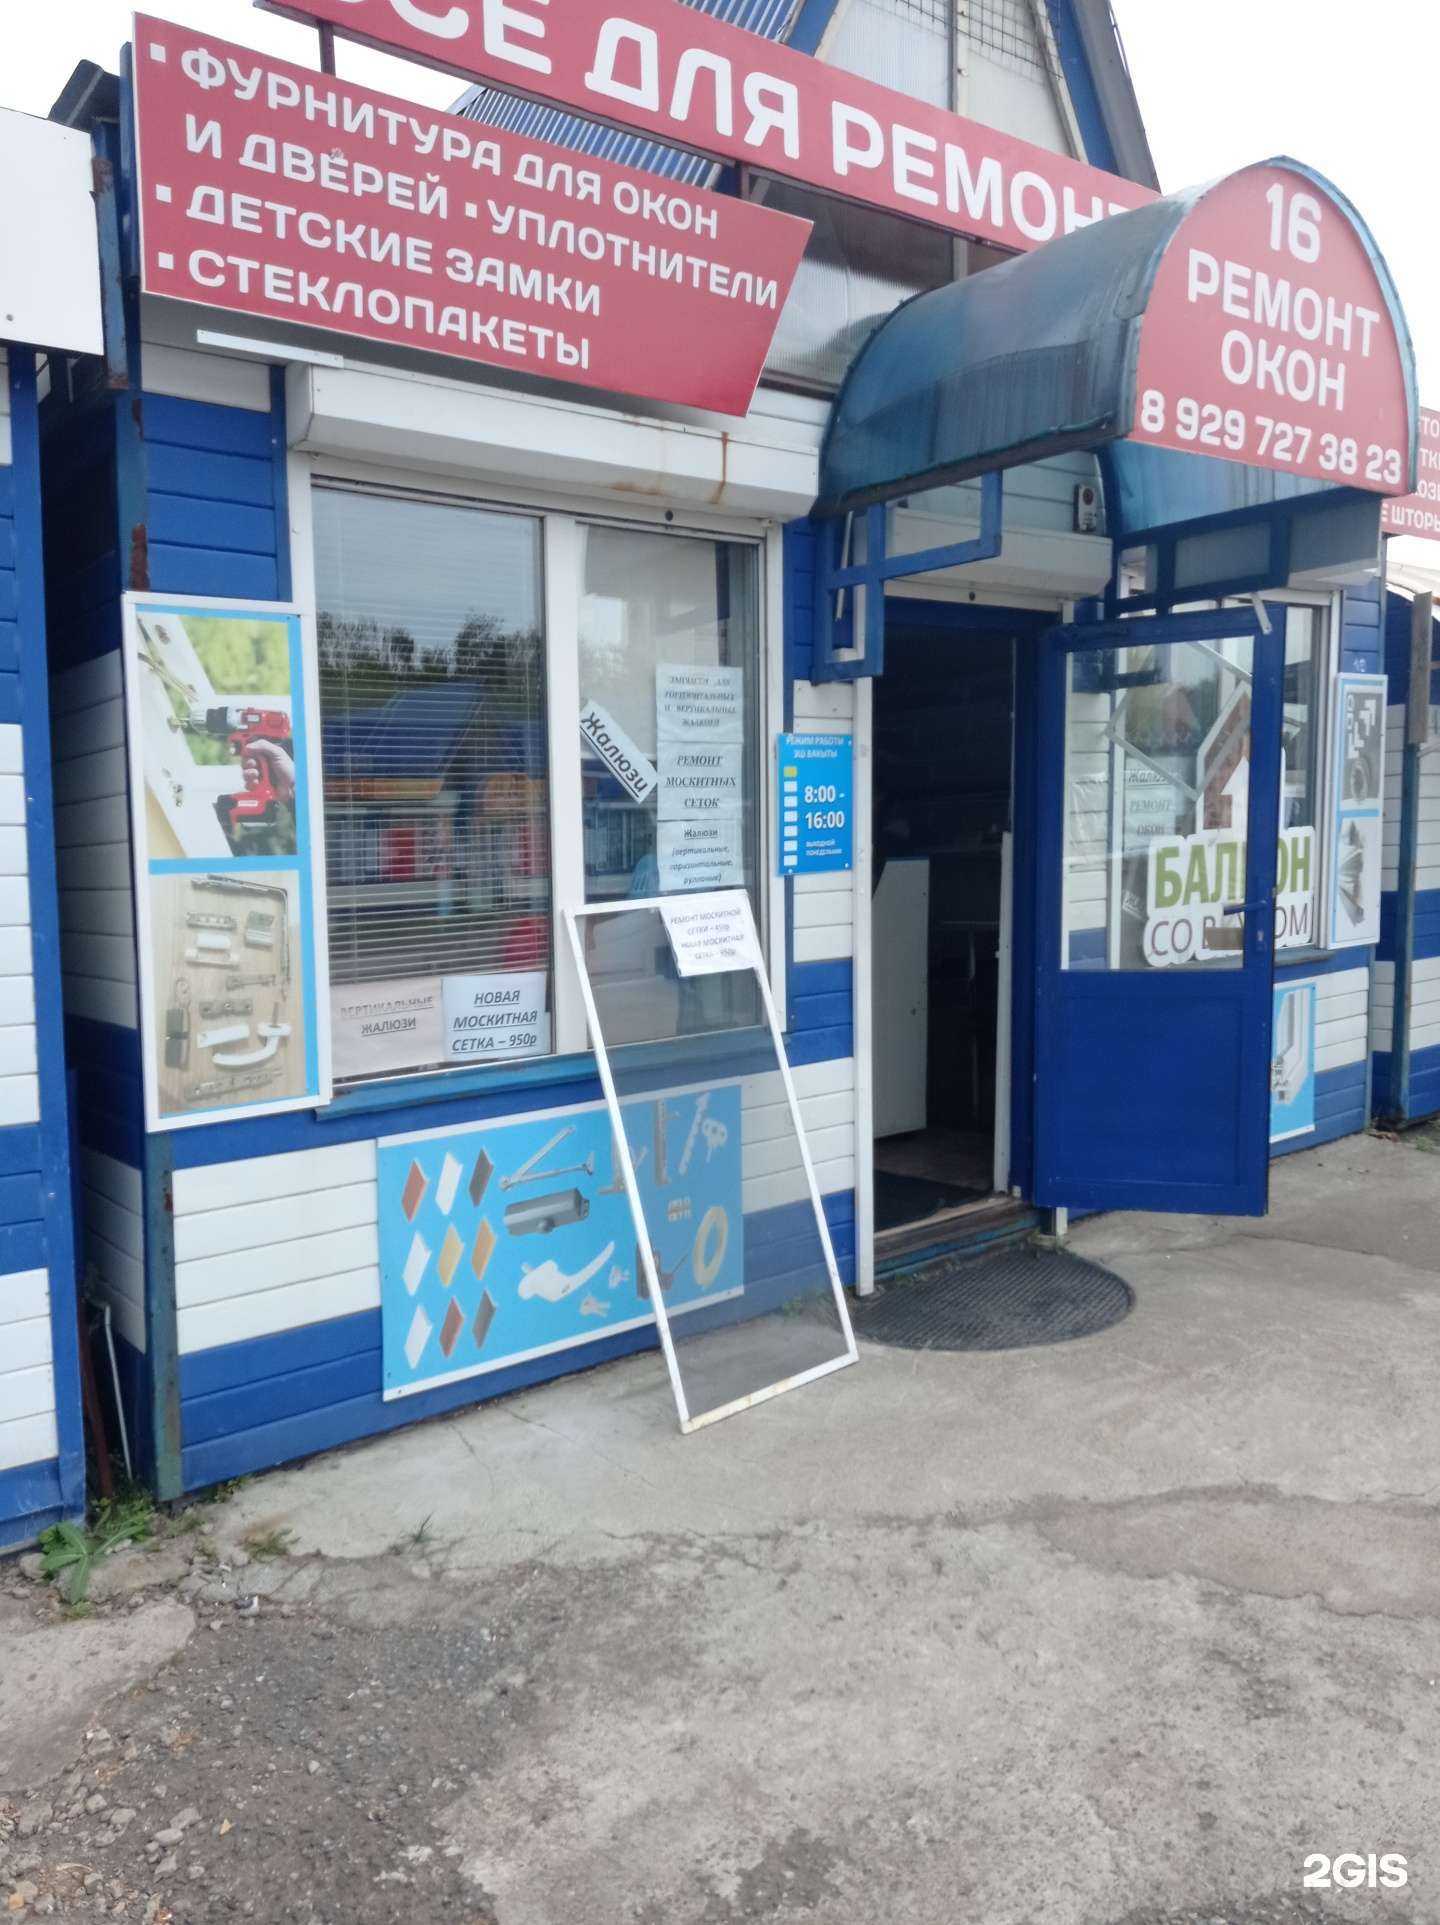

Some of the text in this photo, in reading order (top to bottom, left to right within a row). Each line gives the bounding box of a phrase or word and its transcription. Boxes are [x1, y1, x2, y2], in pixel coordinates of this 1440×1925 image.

[181, 47, 718, 240] ФУРНИТУРА ДЛЯ ОКОН
[585, 17, 799, 160] ДЛЯ
[832, 100, 1131, 241] РЕМОН
[186, 113, 222, 159] И
[488, 199, 778, 310] УПЛОТНИТЕЛИ
[186, 185, 600, 316] ДЕТСКИЕ ЗАМКИ
[1266, 182, 1322, 264] 16
[188, 249, 590, 370] СТЕКЛОПАКЕТЫ
[1187, 248, 1380, 358] РЕМОНТ
[1221, 329, 1346, 412] ОКОН
[1140, 389, 1401, 485] 8 929 727 38 23
[580, 711, 649, 793] Жалюзи
[804, 785, 836, 804] 8:00
[805, 810, 845, 830] 16:00
[1154, 836, 1312, 909] БАЛОН
[361, 1017, 417, 1034] ЖАЛЮЗИ
[453, 1011, 538, 1030] МОСКИТНАЯ
[474, 990, 521, 1005] НОВАЯ
[452, 1036, 495, 1051] СЕТКА
